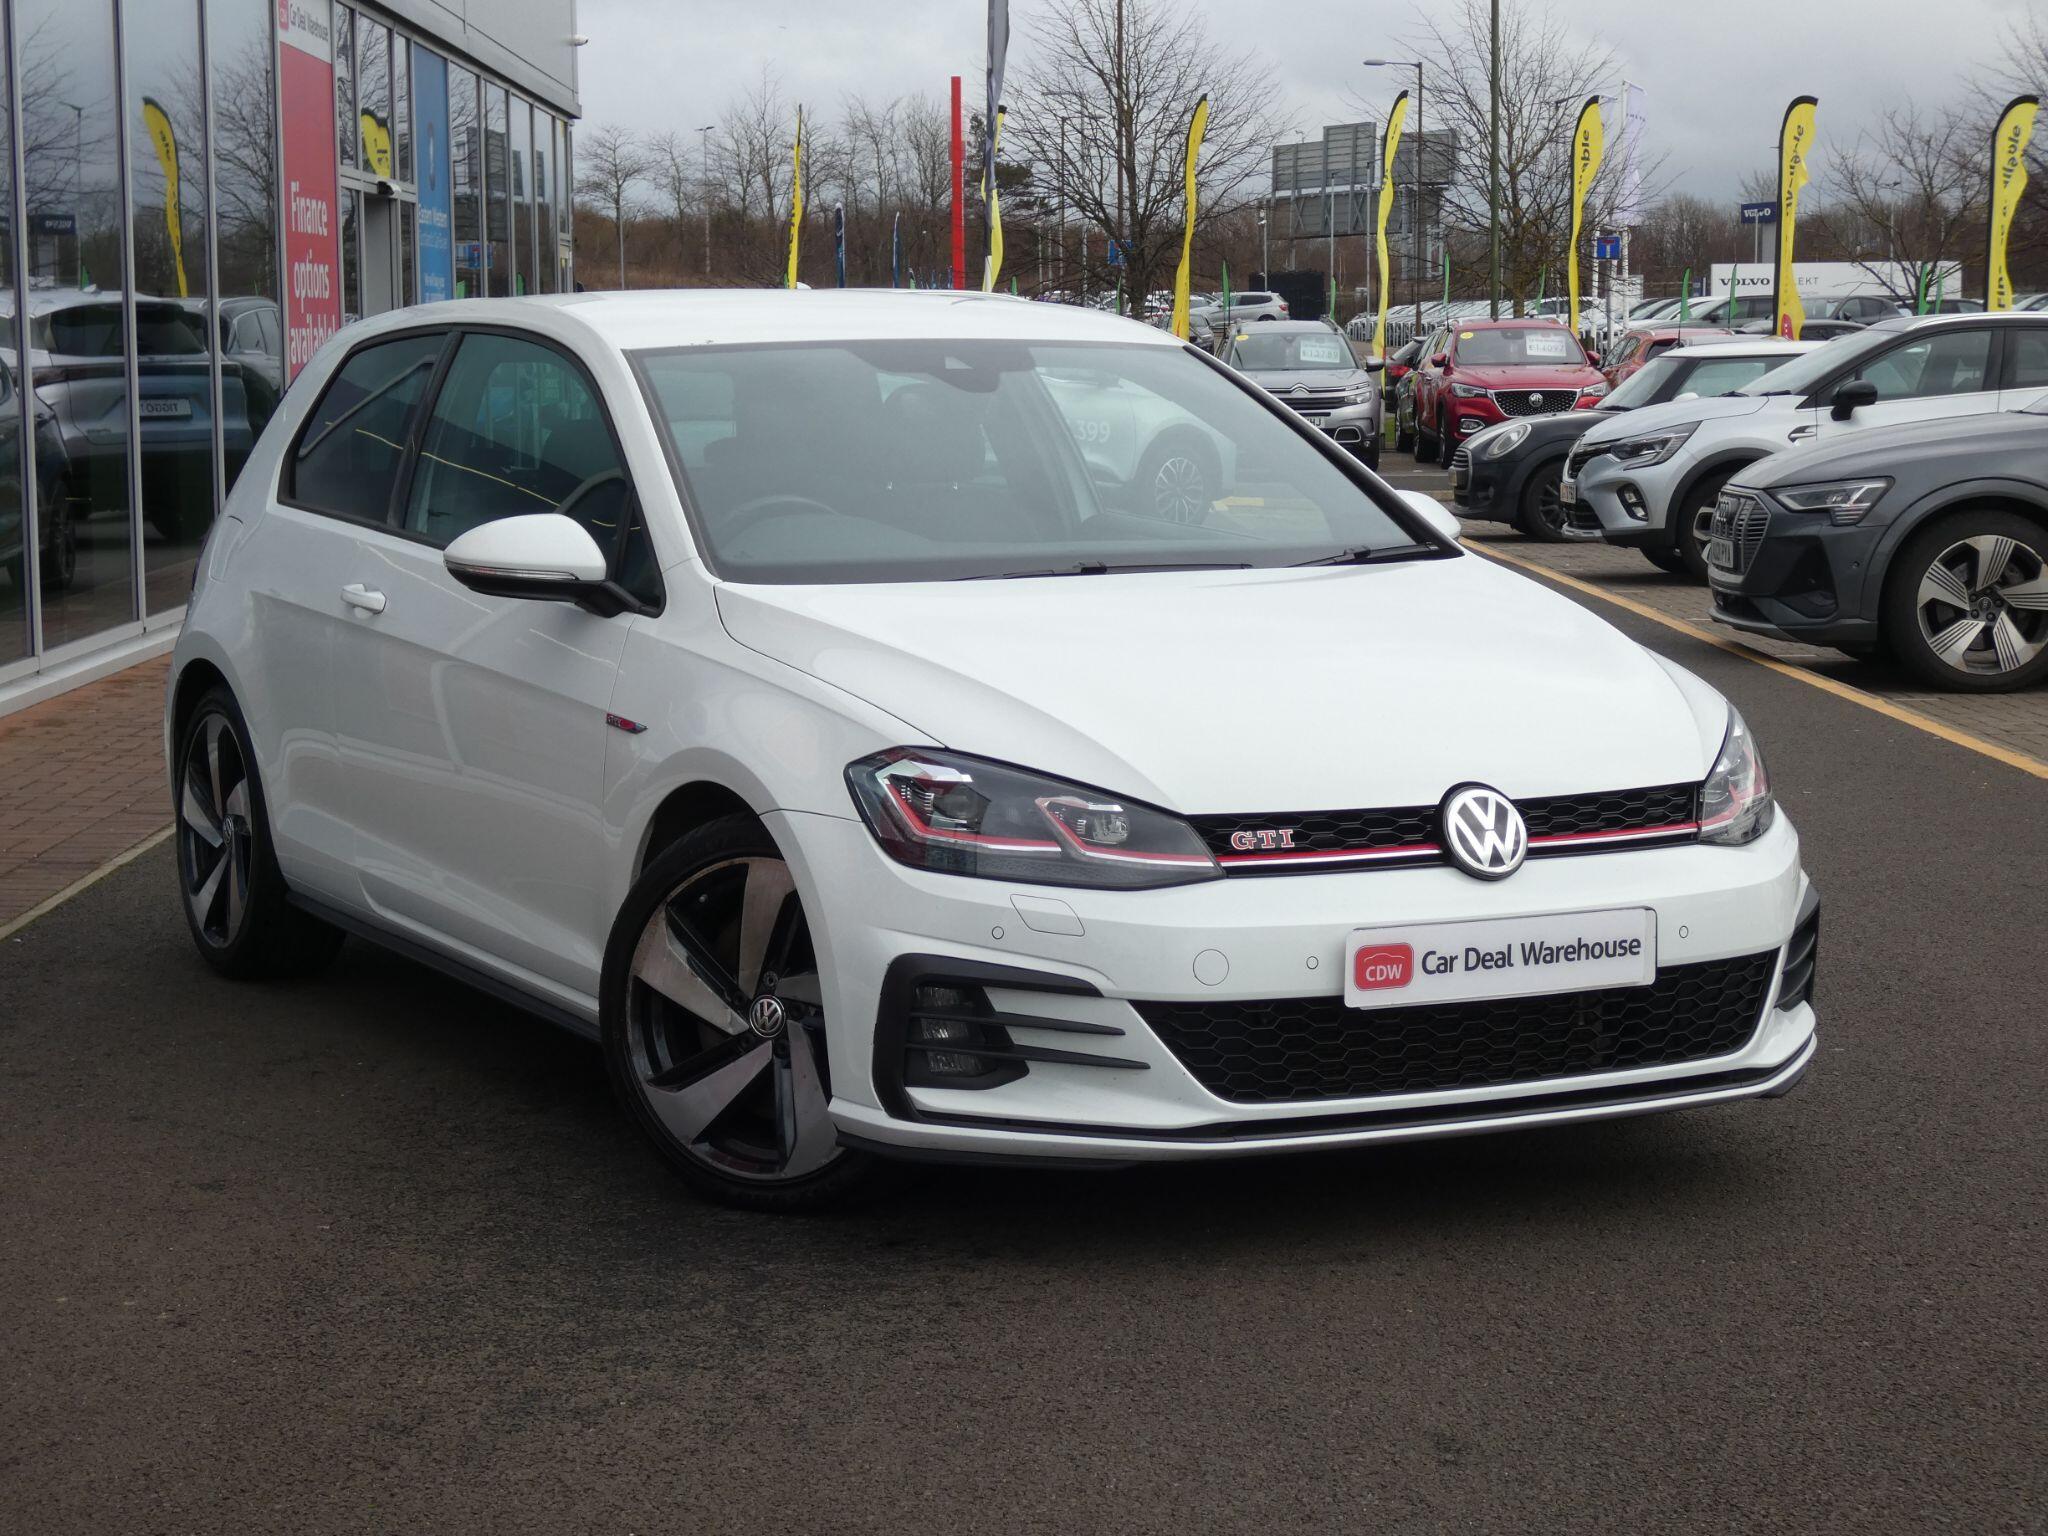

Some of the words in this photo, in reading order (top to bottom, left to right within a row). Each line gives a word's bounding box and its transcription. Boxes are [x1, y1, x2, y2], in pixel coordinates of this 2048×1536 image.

[290, 181, 329, 237] Finance
[294, 249, 330, 314] options
[1231, 829, 1295, 850] GTI
[1365, 963, 1402, 983] CDW
[1421, 950, 1458, 975] Car
[1464, 943, 1514, 972] Deal
[1520, 936, 1642, 966] Warehouse
